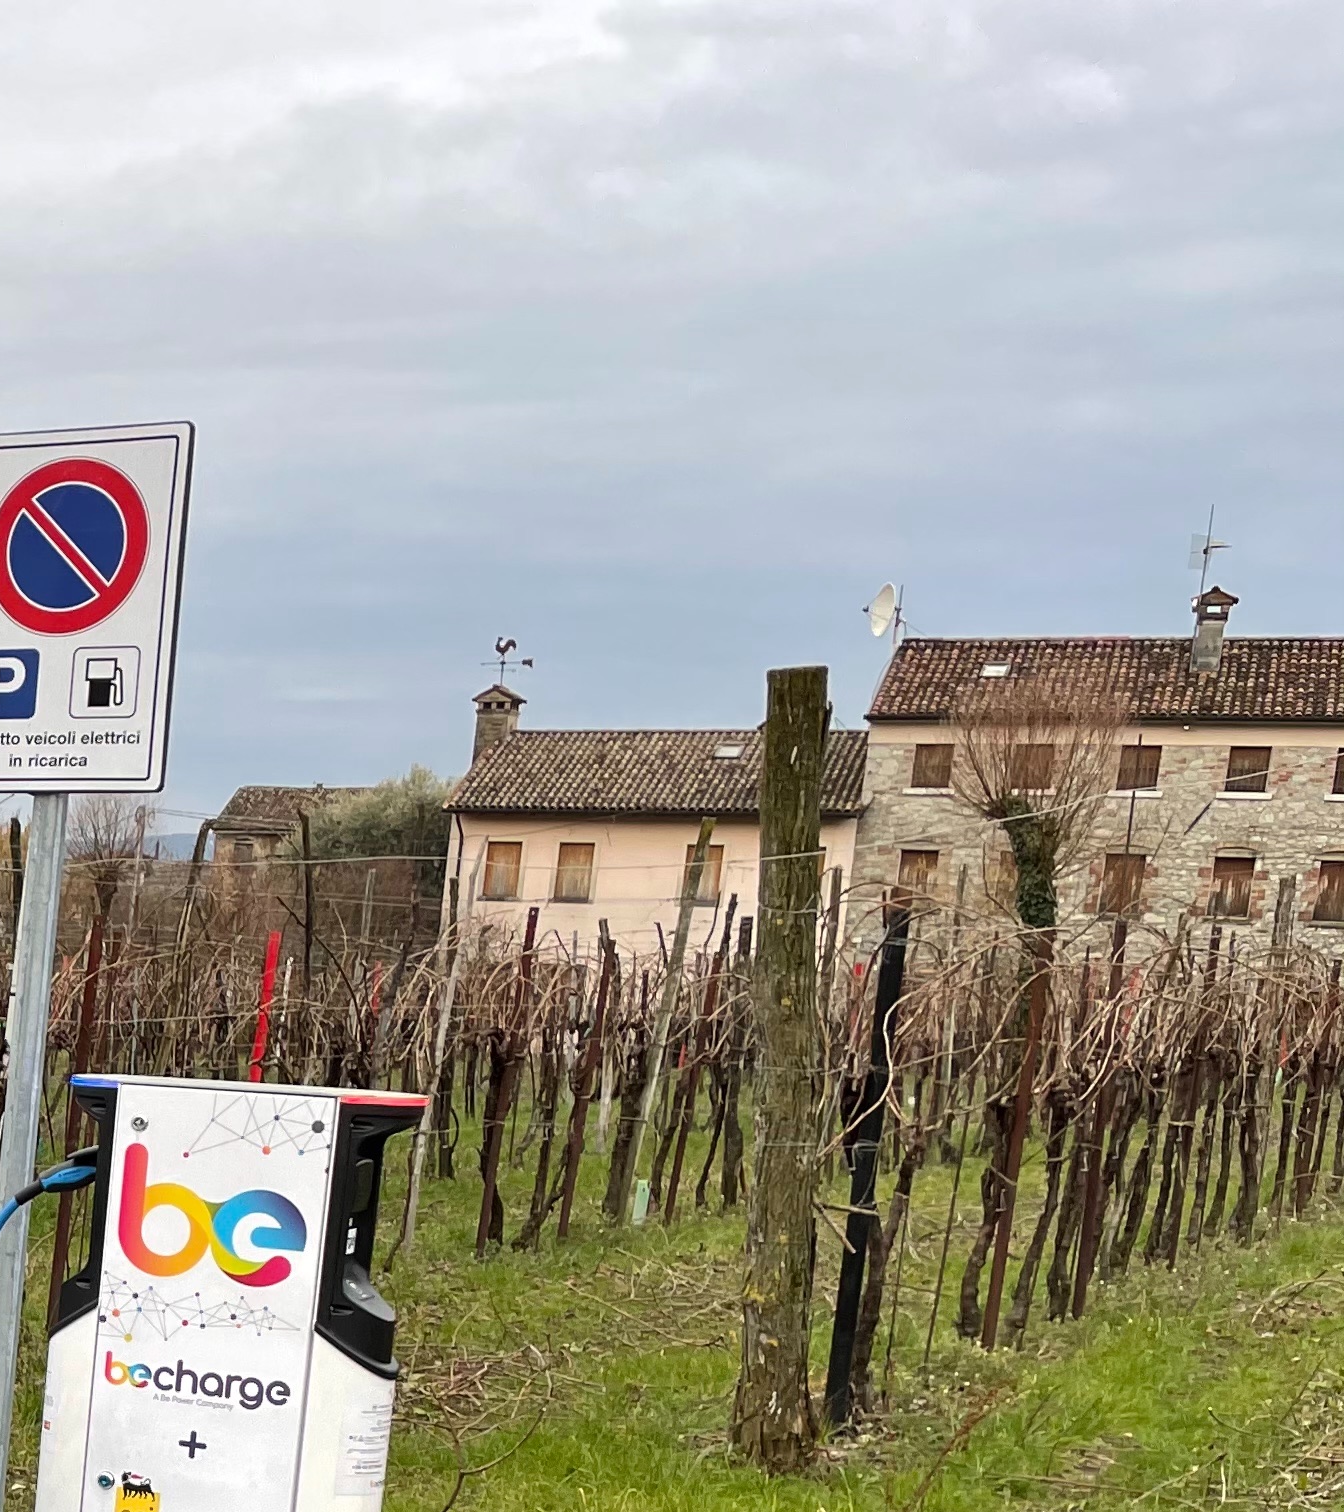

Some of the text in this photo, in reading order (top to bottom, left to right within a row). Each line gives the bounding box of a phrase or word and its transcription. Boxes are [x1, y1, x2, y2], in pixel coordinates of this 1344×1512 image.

[25, 731, 76, 745] veicoli
[80, 730, 140, 745] elettrici
[8, 753, 88, 768] in ricarica
[119, 1142, 307, 1288] be
[105, 1351, 291, 1410] becharge
